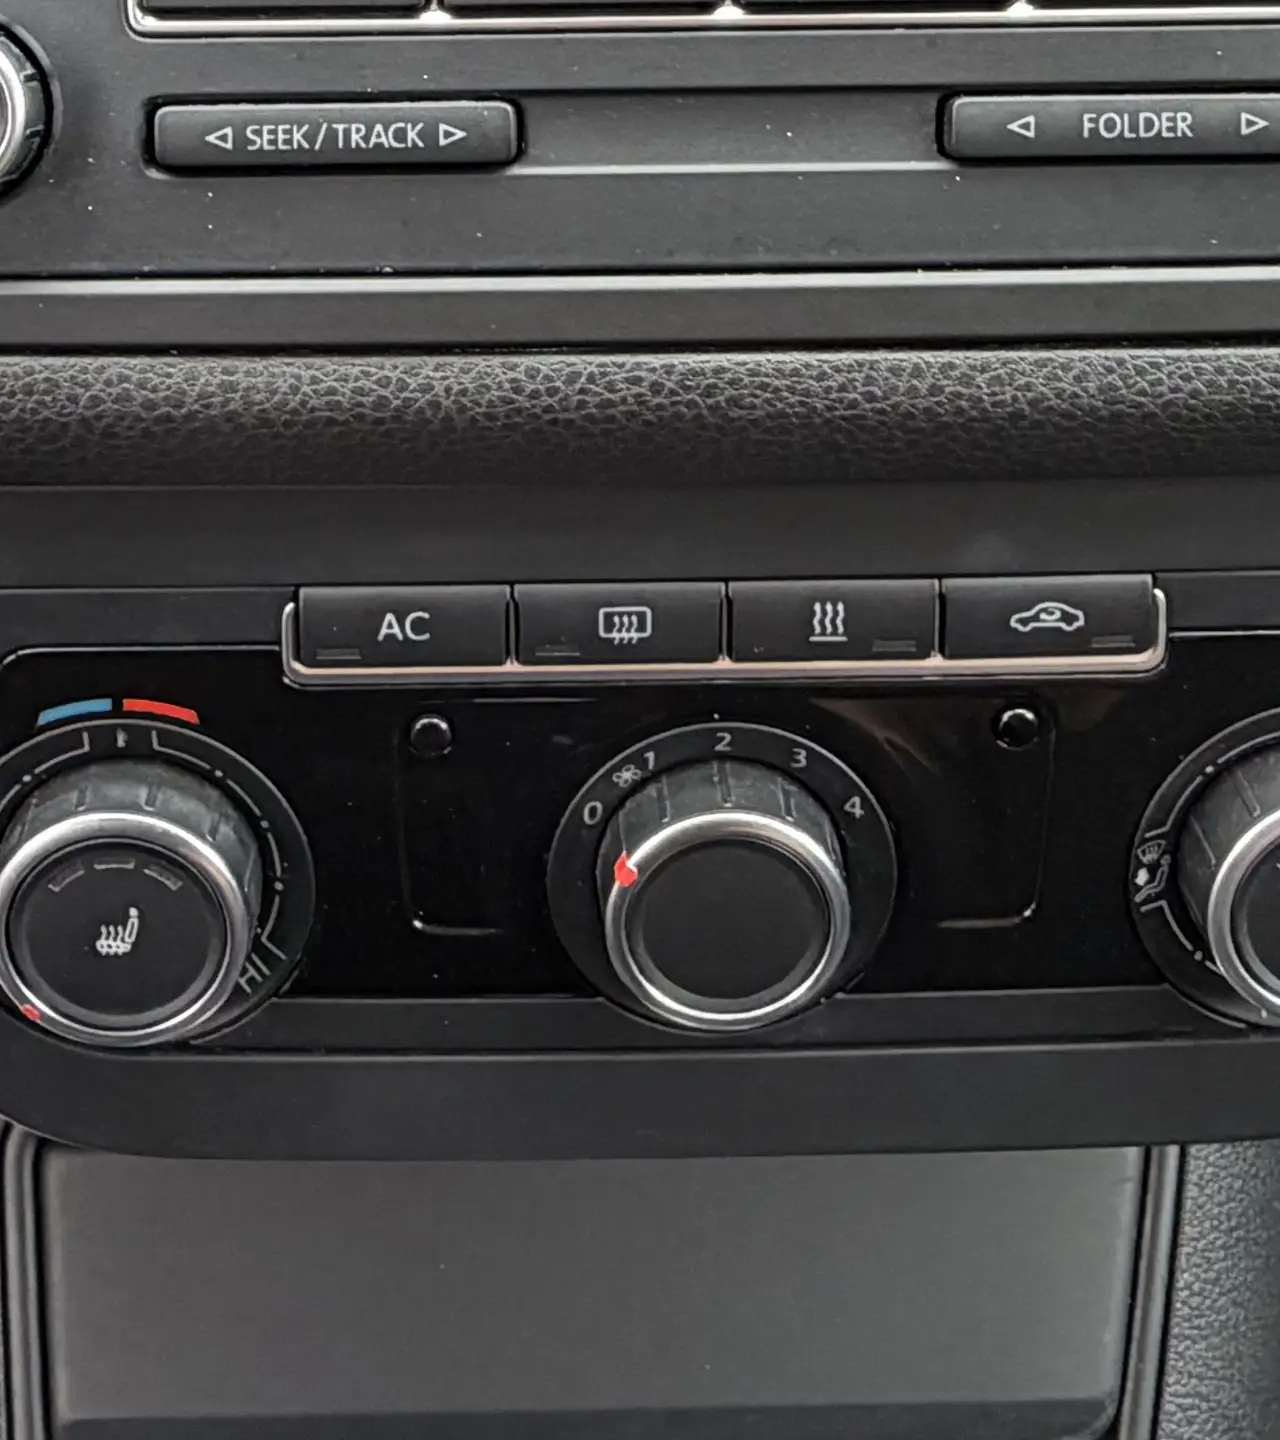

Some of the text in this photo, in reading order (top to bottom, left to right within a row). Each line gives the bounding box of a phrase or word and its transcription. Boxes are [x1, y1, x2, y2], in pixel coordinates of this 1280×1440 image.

[1082, 111, 1195, 140] FOLDER
[376, 610, 431, 642] AC
[713, 732, 733, 752] 2
[643, 750, 657, 771] 1
[789, 748, 808, 768] 3
[582, 801, 604, 826] 0
[843, 795, 865, 820] 4
